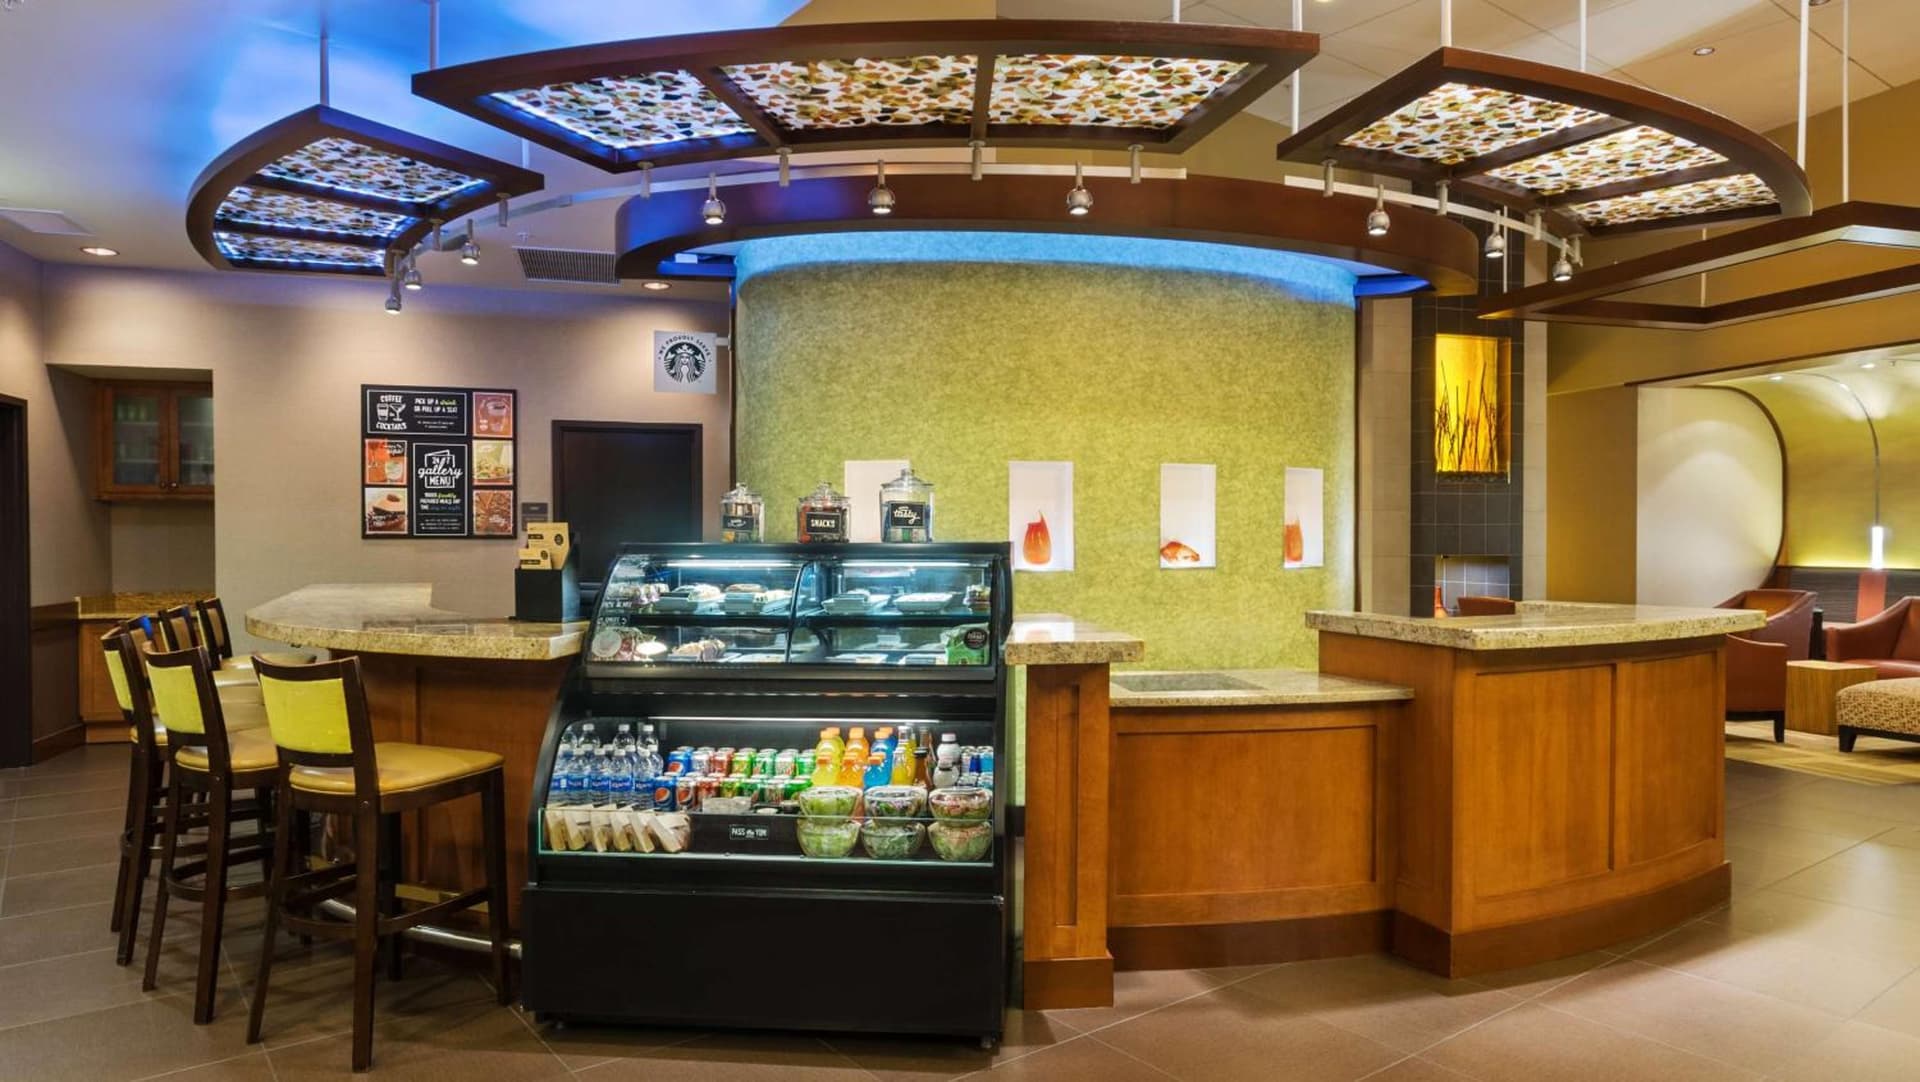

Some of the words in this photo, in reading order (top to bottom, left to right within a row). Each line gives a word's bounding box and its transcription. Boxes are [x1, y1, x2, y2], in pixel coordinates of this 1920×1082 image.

[665, 335, 694, 344] PROUDLY
[380, 395, 402, 403] COFFEE
[376, 422, 407, 430] COCKTAILS
[418, 459, 463, 479] gallery
[429, 475, 452, 486] MENU
[894, 509, 920, 524] tasty
[811, 519, 835, 528] SNACKS
[731, 827, 746, 836] PASS
